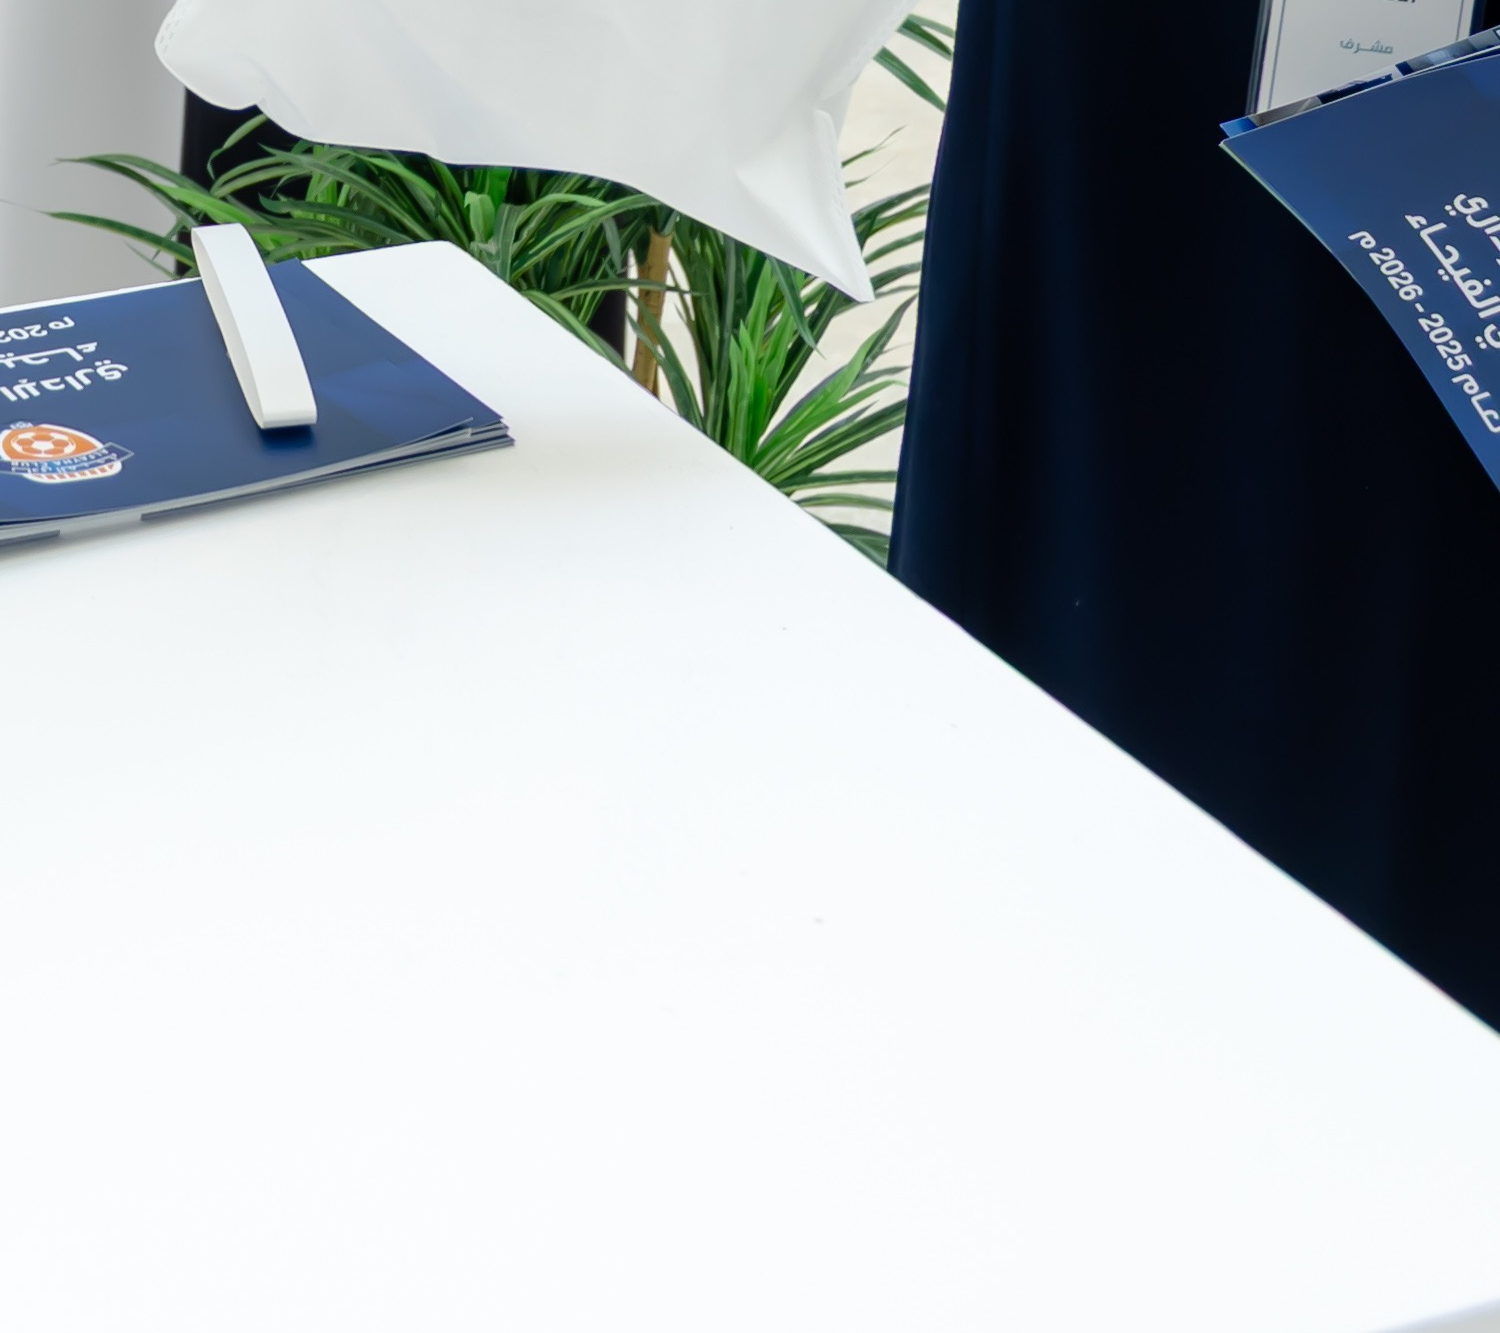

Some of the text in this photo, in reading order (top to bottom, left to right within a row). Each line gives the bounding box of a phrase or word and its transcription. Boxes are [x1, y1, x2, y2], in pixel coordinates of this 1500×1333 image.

[1339, 37, 1394, 55] مشرف
[1347, 231, 1377, 249] م
[1368, 247, 1423, 301] 2026
[48, 316, 75, 330] م
[1418, 313, 1473, 371] 2025
